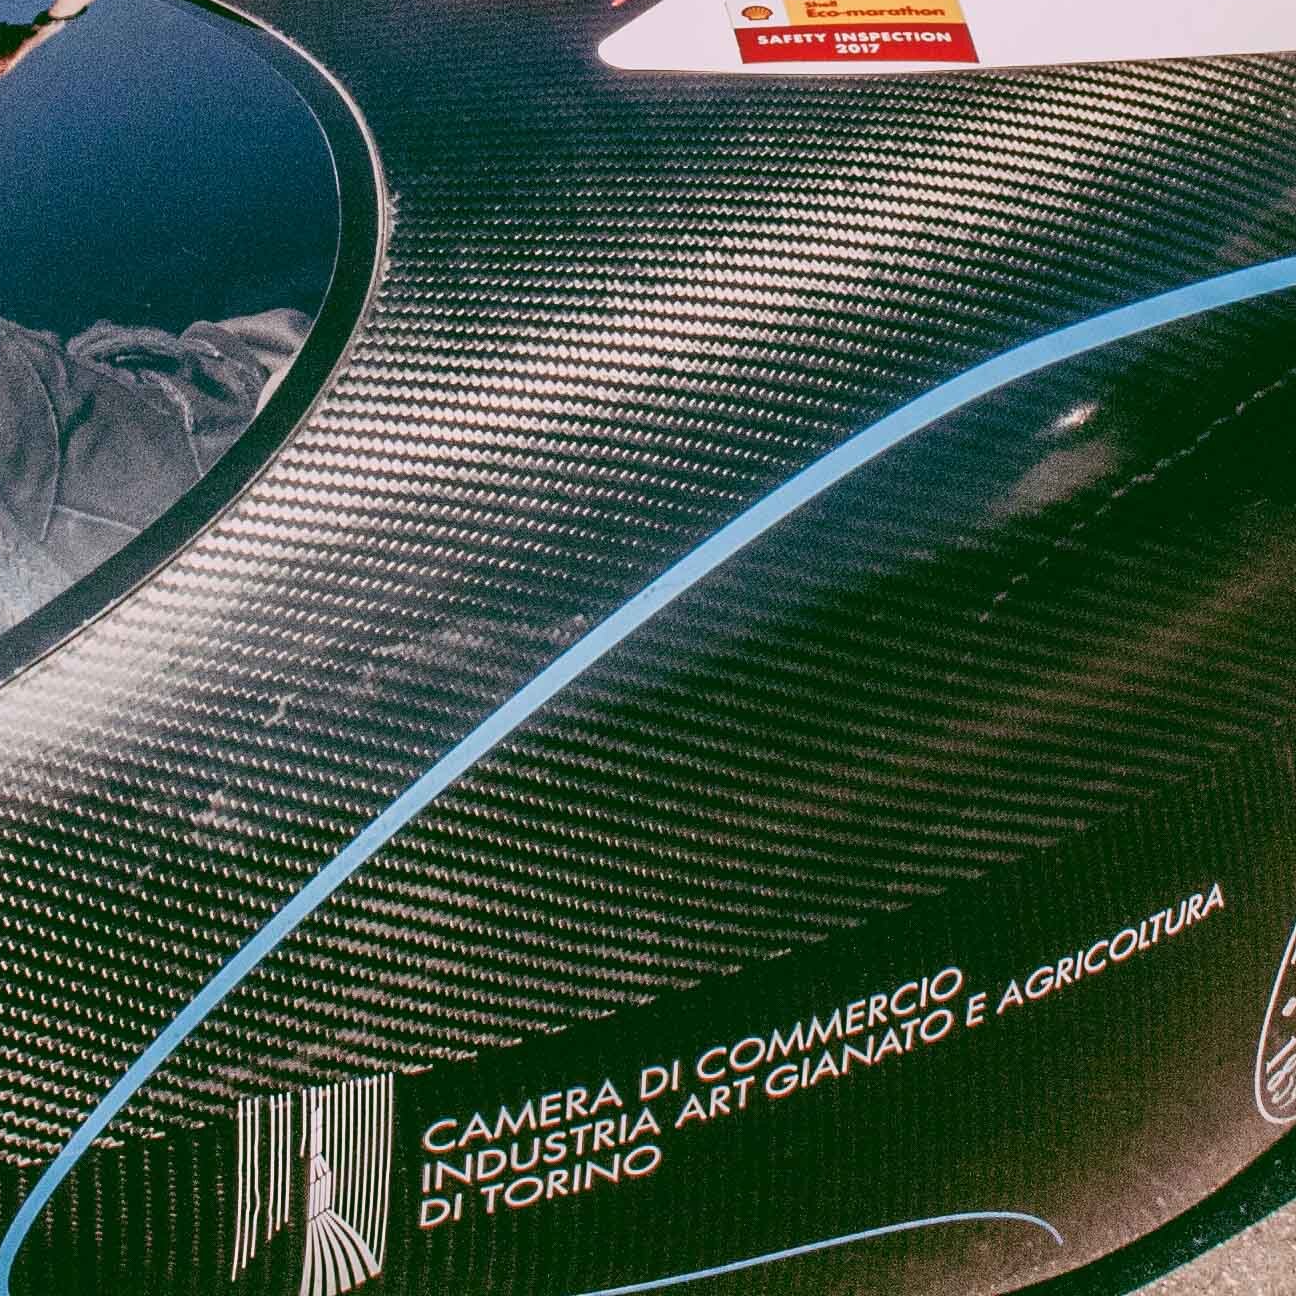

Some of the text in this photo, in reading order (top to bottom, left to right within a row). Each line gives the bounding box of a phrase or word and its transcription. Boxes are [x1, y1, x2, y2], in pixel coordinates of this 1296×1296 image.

[804, 0, 838, 9] Shell
[806, 5, 946, 19] Eco-marathon
[756, 31, 953, 46] SAFETY INSPECTION
[834, 43, 881, 54] 2017
[421, 1106, 662, 1194] INDUSTRIA
[965, 991, 988, 1028] E
[995, 882, 1225, 1016] AGRICOLTURA
[422, 966, 964, 1153] CAMERA DI COMMERCIO
[418, 1144, 663, 1230] DI TORINO
